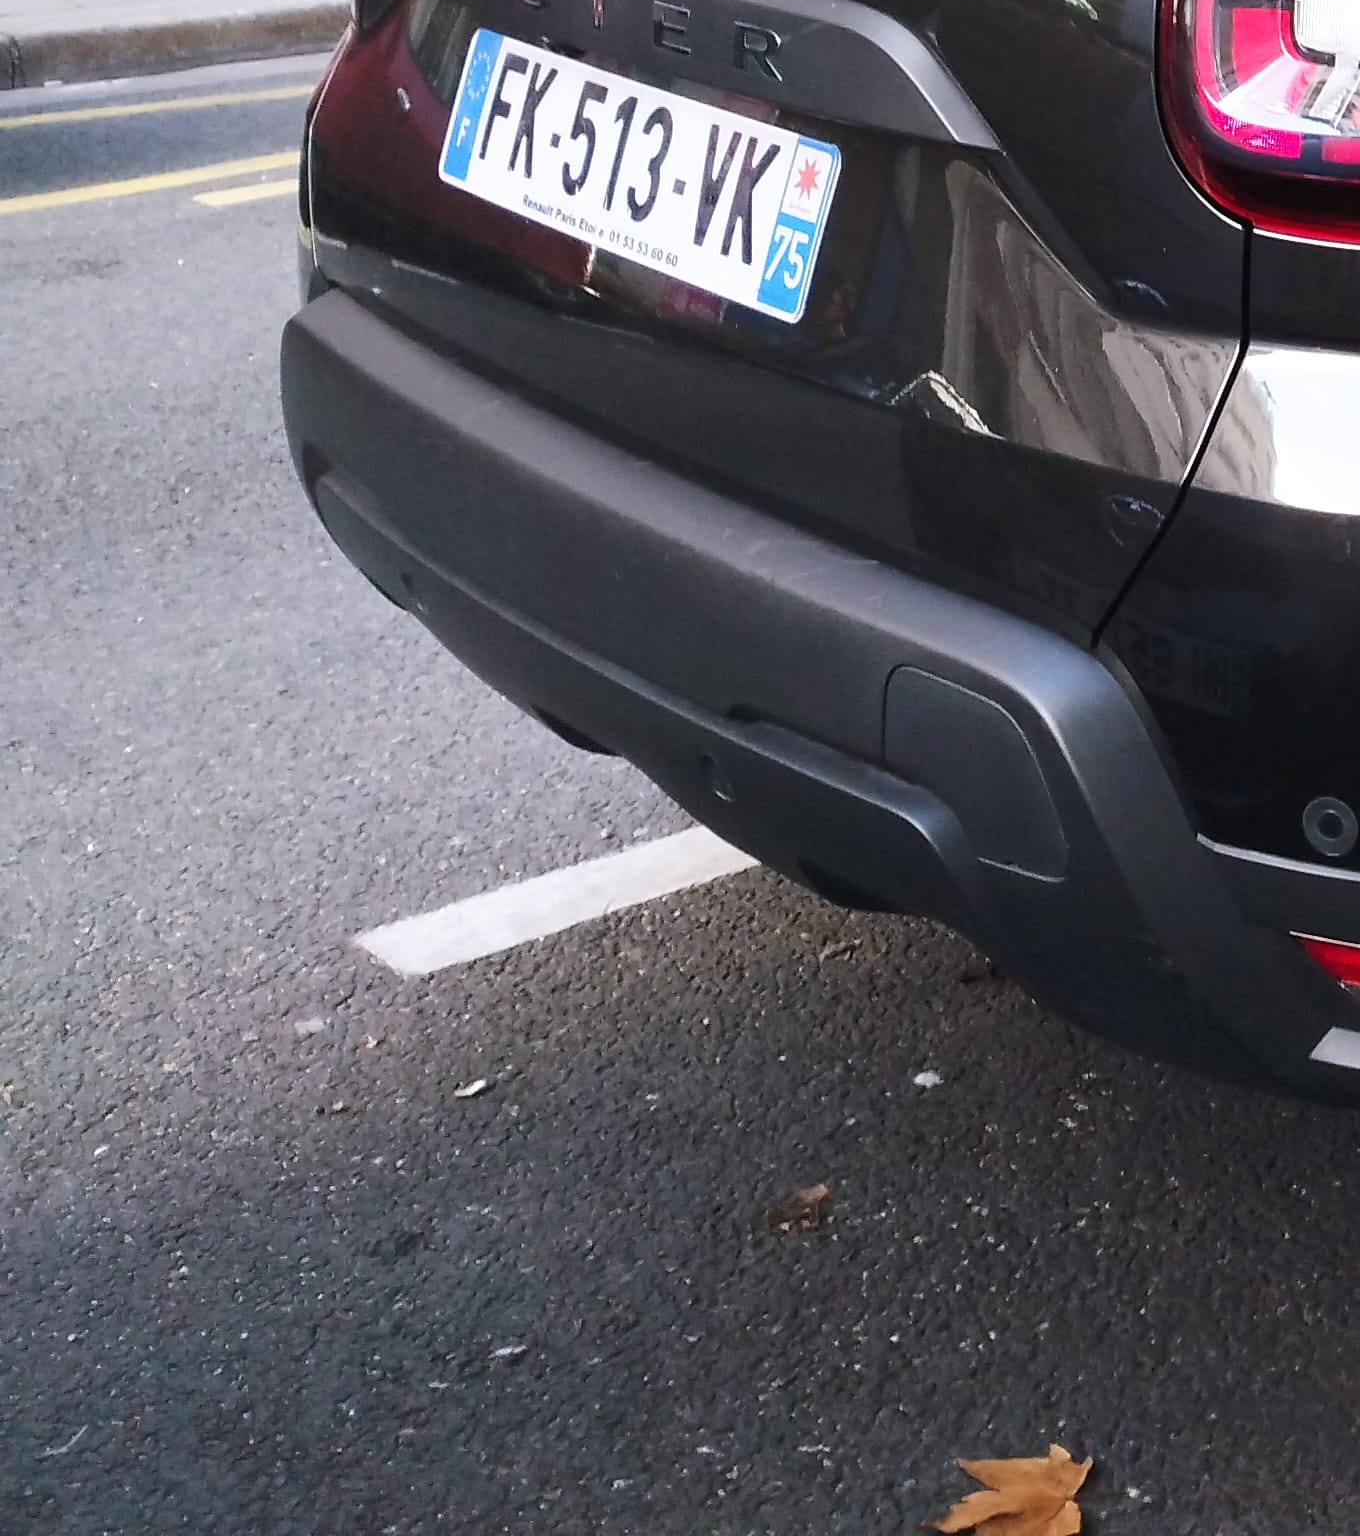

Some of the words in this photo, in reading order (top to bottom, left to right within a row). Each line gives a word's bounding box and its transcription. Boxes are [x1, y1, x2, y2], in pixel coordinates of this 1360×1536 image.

[456, 117, 471, 148] F
[478, 51, 782, 266] FK-513-VK
[522, 193, 554, 215] Renault
[555, 207, 577, 228] Paris
[578, 216, 605, 238] Etoie
[609, 230, 621, 244] 01
[622, 235, 635, 251] 53
[636, 239, 649, 256] 53
[764, 224, 811, 291] 75
